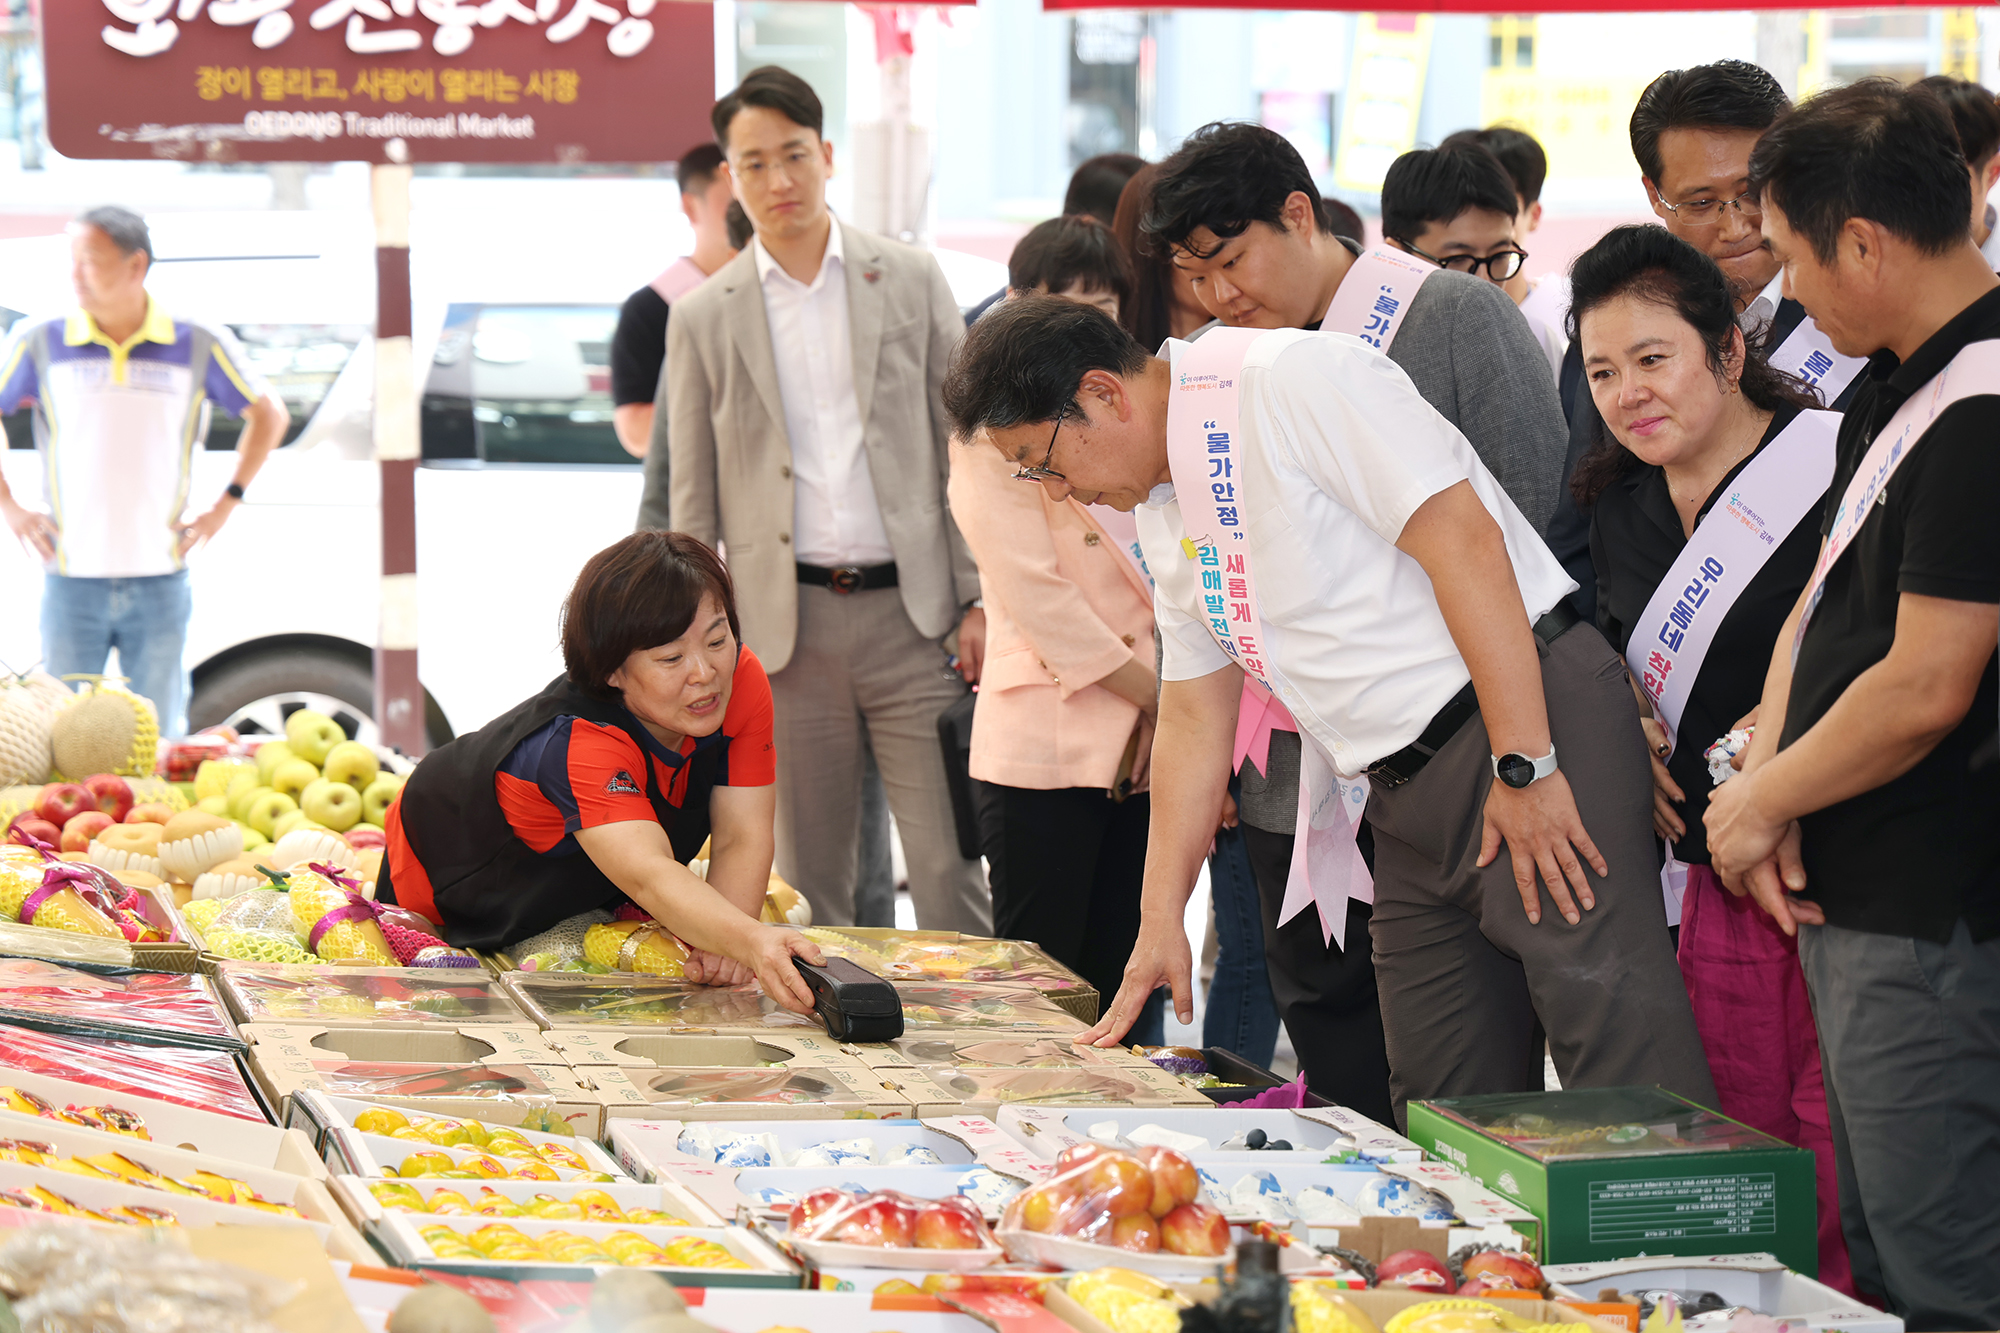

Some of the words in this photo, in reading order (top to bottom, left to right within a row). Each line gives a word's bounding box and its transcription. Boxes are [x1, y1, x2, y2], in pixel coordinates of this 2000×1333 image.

[256, 67, 348, 101] 열리고,
[353, 67, 435, 103] 사랑이
[439, 67, 522, 104] 열리는
[524, 68, 580, 104] 시장
[343, 111, 457, 138] Traditional
[457, 112, 536, 139] Market
[1219, 380, 1233, 389] 김해
[1203, 421, 1244, 540] “물가안정”
[1759, 530, 1775, 545] 김해
[1225, 554, 1251, 623] 새롭게
[1659, 556, 1724, 653] 우리동네
[1434, 1138, 1453, 1160] Muscat
[1453, 1147, 1467, 1168] Shine
